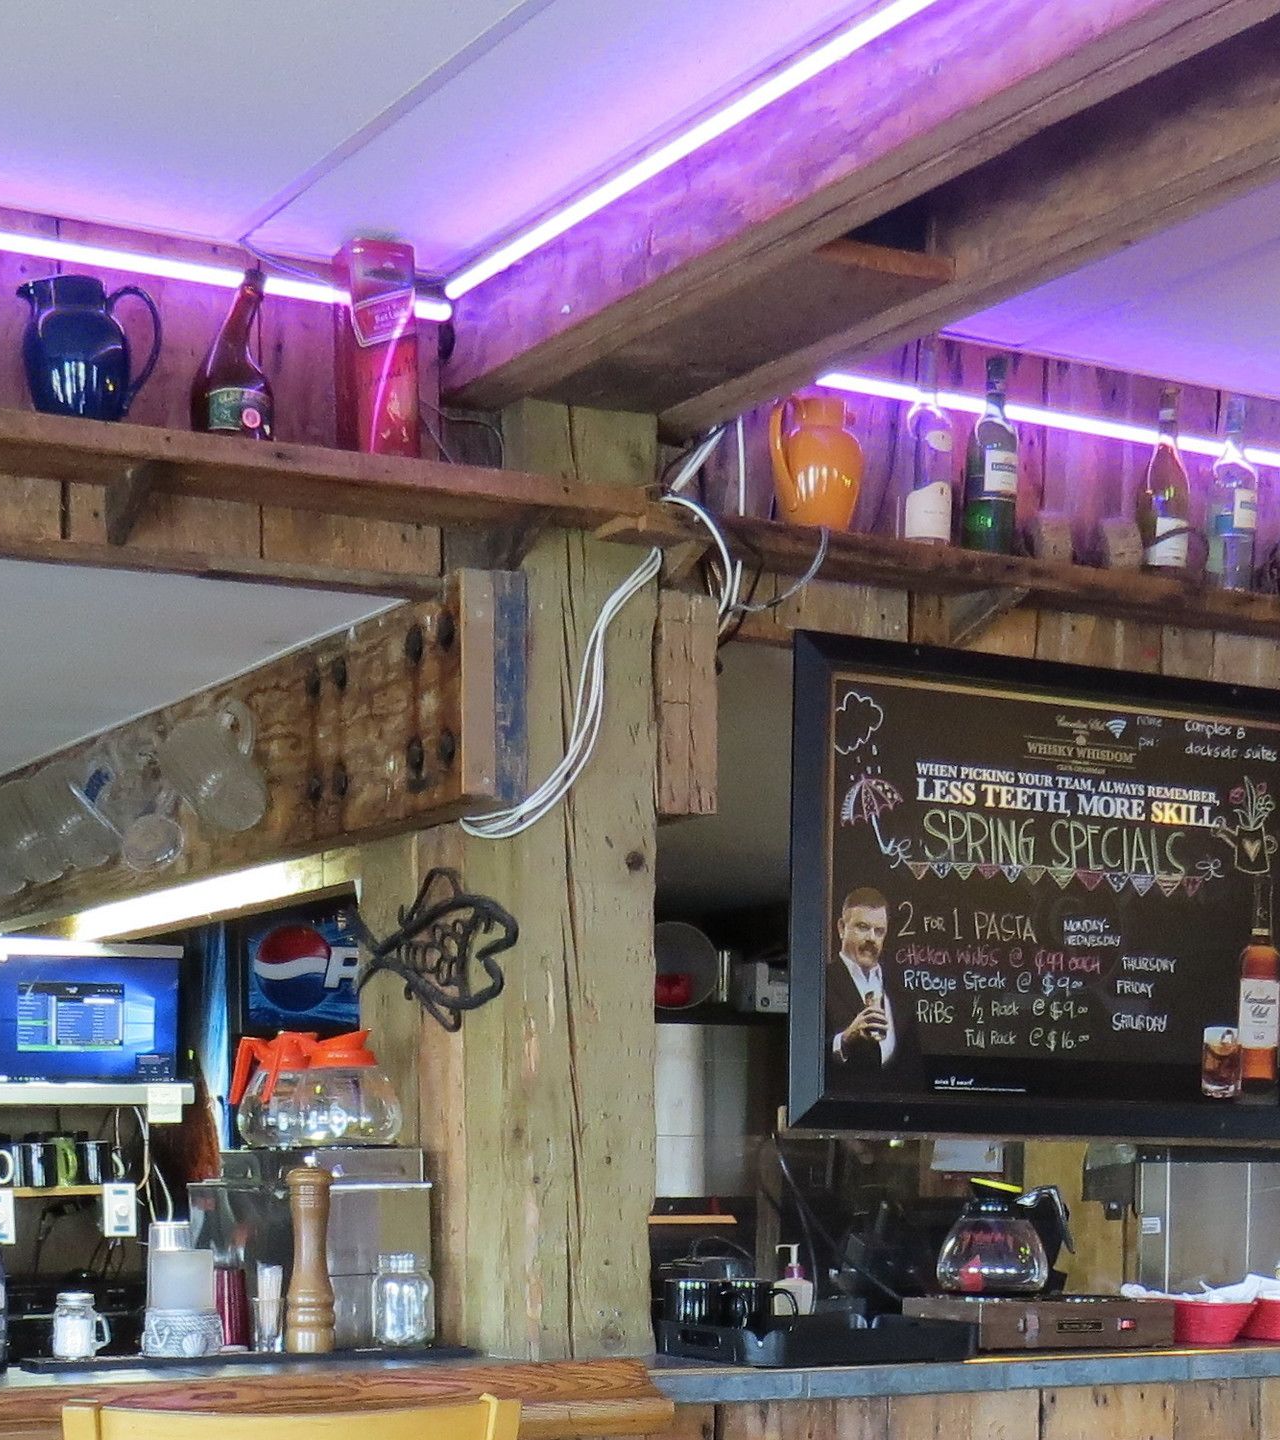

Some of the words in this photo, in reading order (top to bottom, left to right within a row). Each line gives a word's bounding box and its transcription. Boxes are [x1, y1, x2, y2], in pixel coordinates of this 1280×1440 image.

[1027, 741, 1075, 758] WHISKY
[1243, 745, 1279, 763] suites
[916, 762, 958, 779] WHEN
[960, 766, 1016, 785] PICKING
[1018, 771, 1054, 789] YOUR
[1055, 775, 1096, 794] TEAM,
[1098, 780, 1145, 797] ALWAYS
[1147, 785, 1220, 806] REMEMBER,
[916, 777, 976, 806] LESS
[981, 784, 1072, 819] TEETH,
[1077, 794, 1146, 822] MORE
[923, 808, 1036, 867] SPRING
[1049, 818, 1186, 879] SPECIALS
[898, 901, 915, 938] 2
[923, 915, 946, 933] FOR
[952, 907, 963, 941] 1
[974, 911, 1038, 944] PASTA
[1008, 951, 1024, 968] @
[1121, 955, 1177, 974] THURSDAY
[1016, 971, 1032, 994] @
[1116, 979, 1156, 999] FRIDAY
[1032, 998, 1045, 1017] @
[990, 1030, 1017, 1047] Rack
[1029, 1027, 1045, 1048] @
